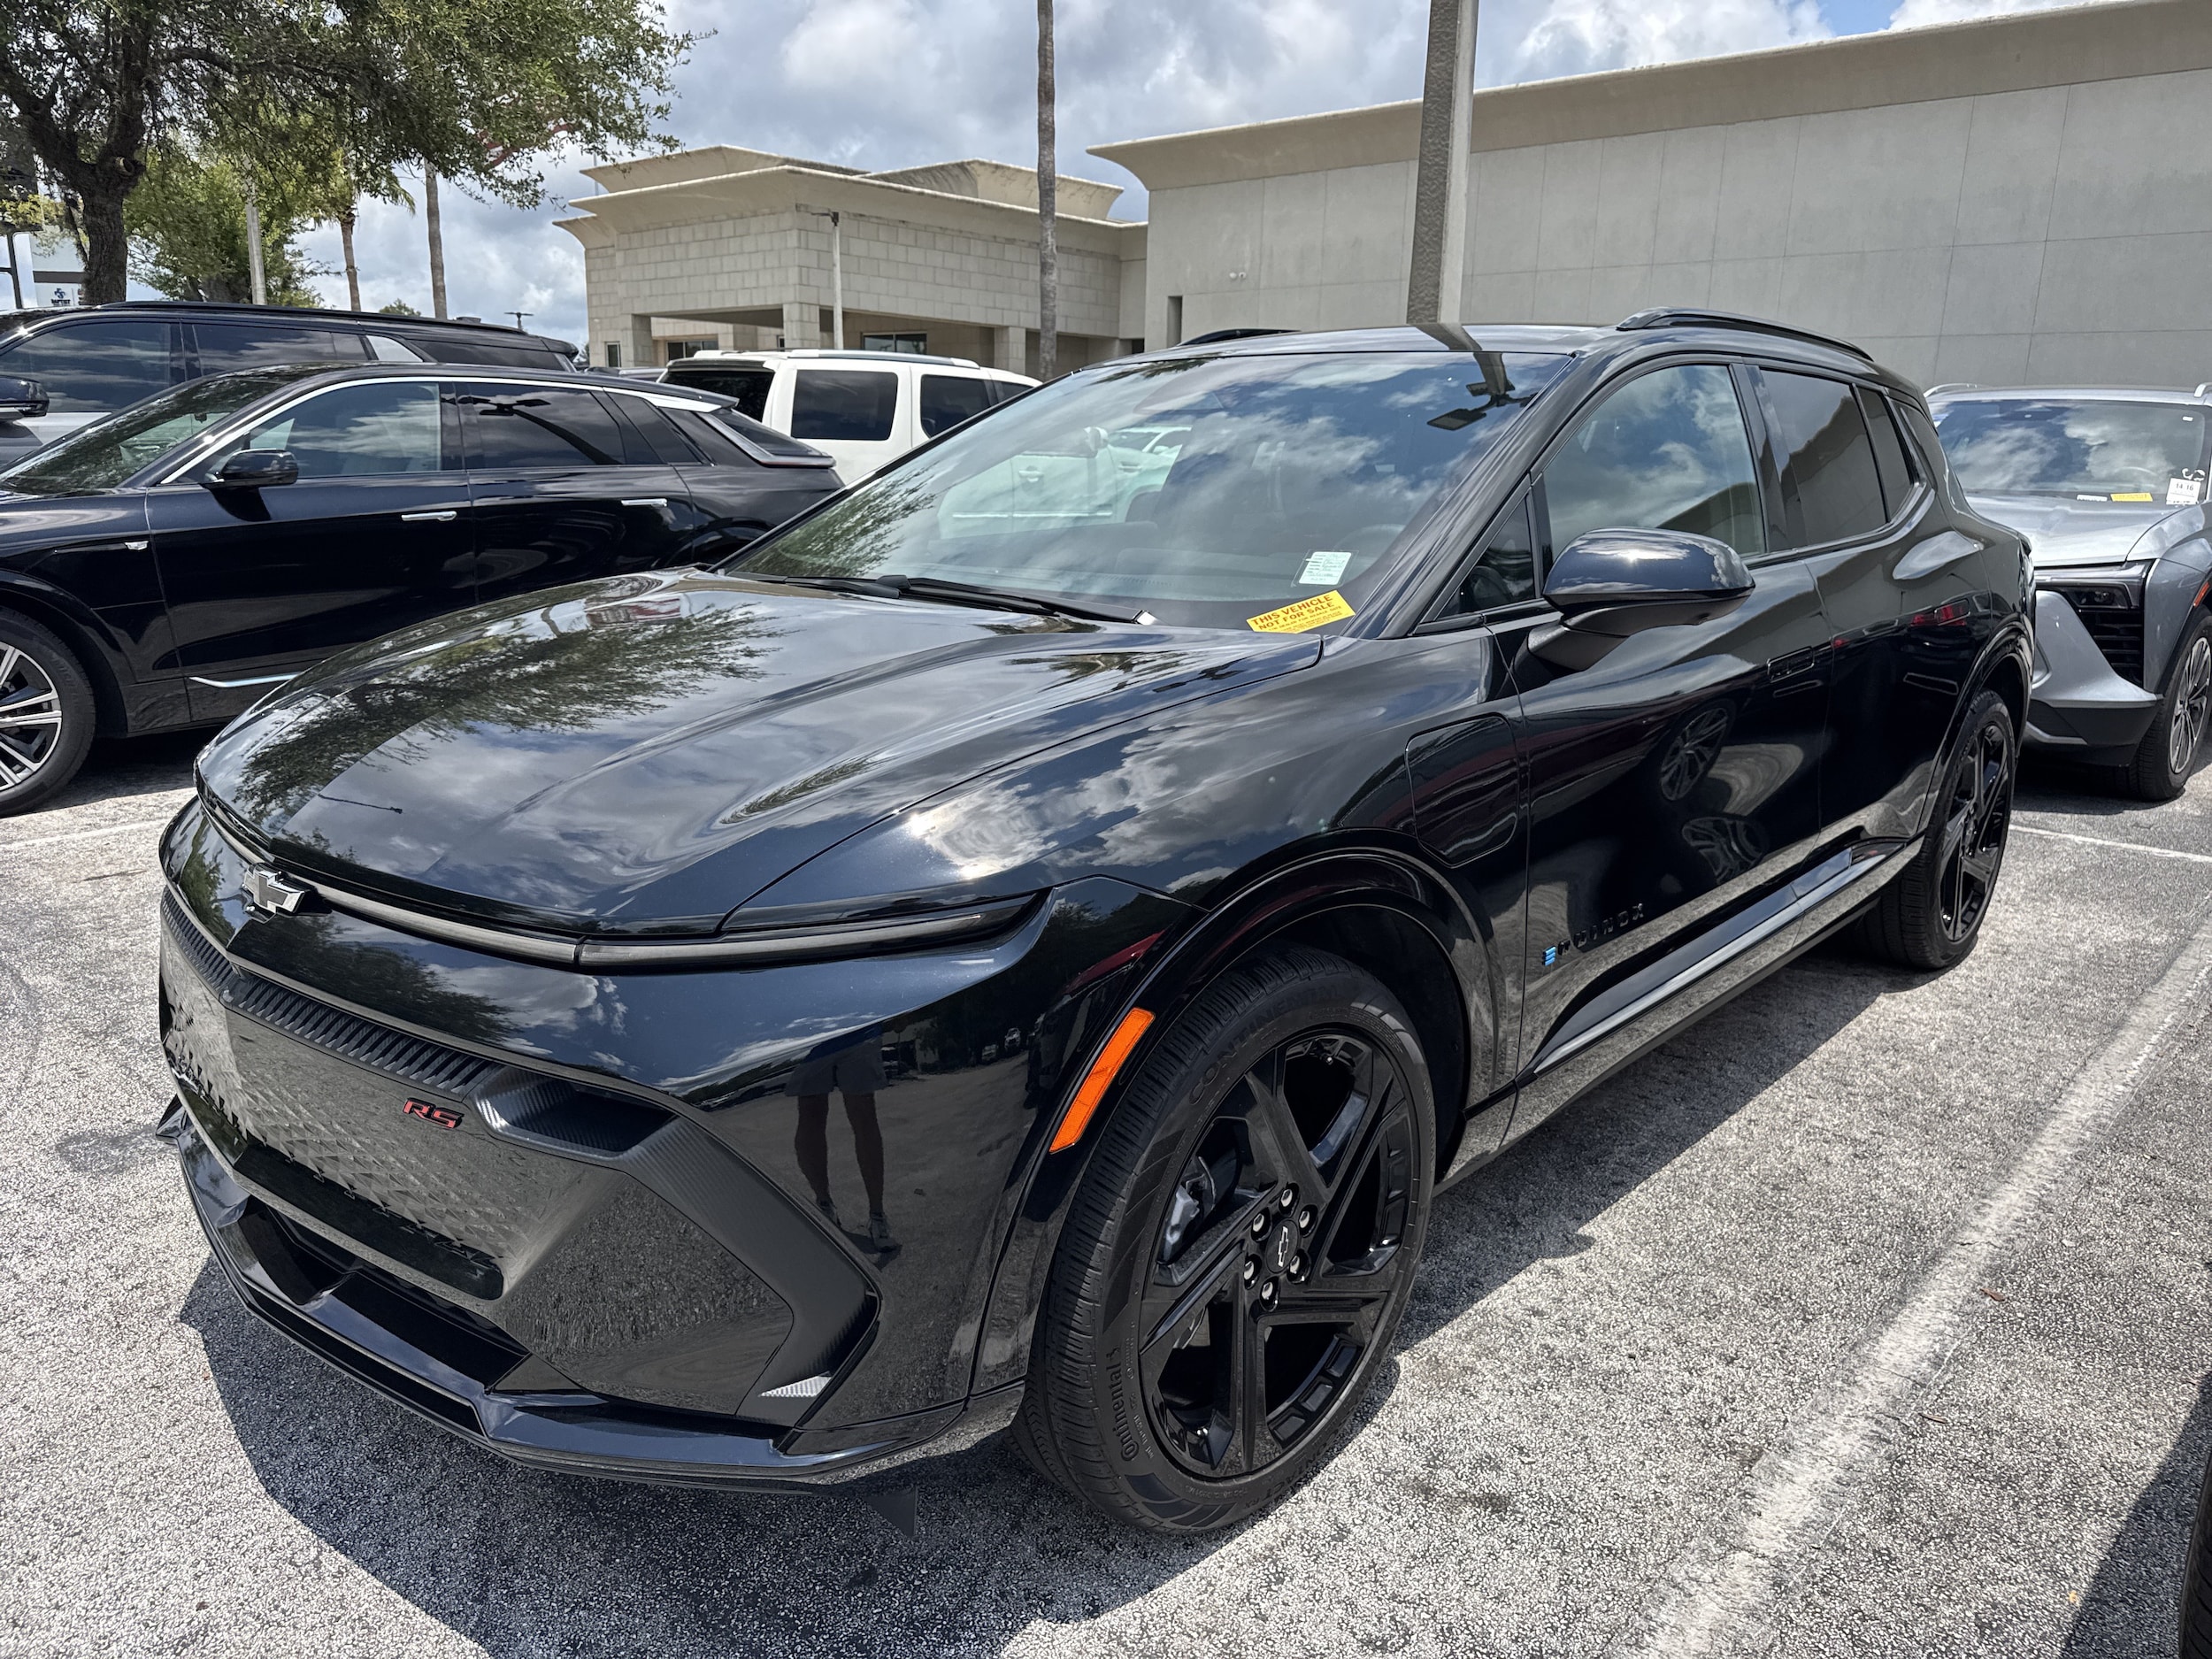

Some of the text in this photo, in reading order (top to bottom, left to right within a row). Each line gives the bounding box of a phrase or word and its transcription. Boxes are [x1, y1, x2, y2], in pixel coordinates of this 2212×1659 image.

[1251, 612, 1280, 626] THIS
[1281, 595, 1333, 615] VEHICLE
[1258, 619, 1280, 630] NOT
[1283, 612, 1305, 622] FOR
[1307, 602, 1335, 614] SALE
[403, 1097, 465, 1128] RS
[1105, 1363, 1140, 1462] Continental
